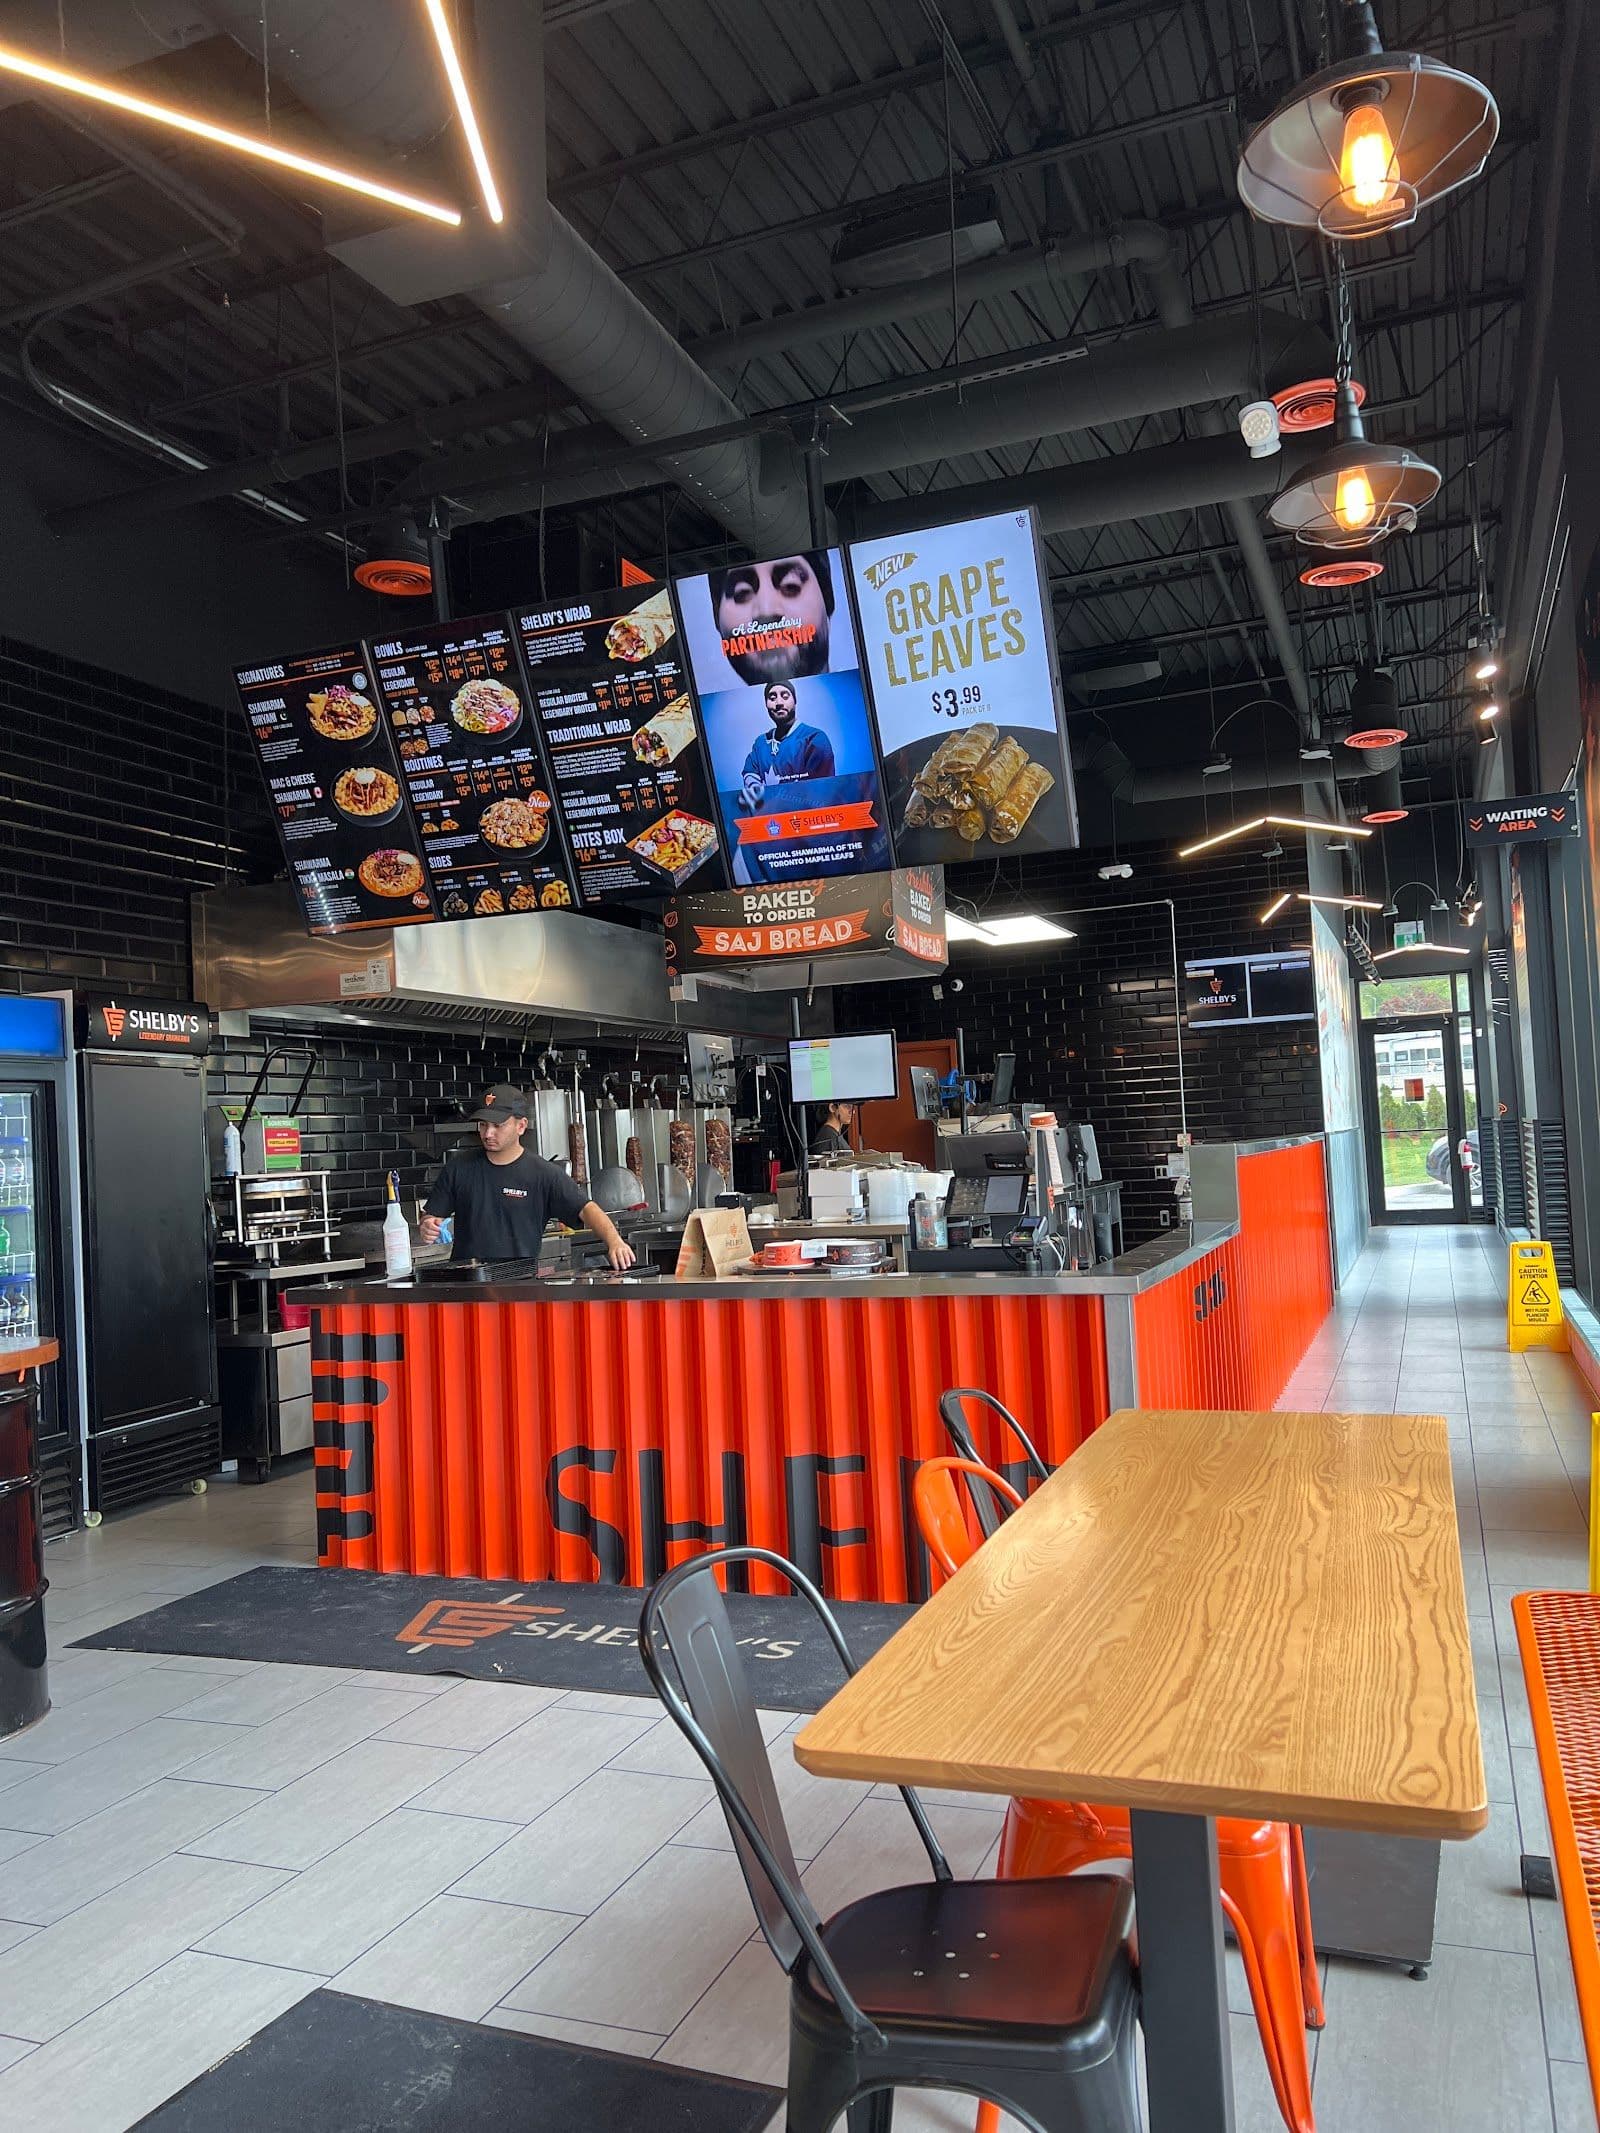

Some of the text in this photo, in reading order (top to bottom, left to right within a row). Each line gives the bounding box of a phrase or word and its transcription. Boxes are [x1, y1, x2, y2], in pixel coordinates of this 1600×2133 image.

[875, 552, 906, 587] NEW
[885, 558, 1010, 636] GRAPE
[521, 605, 592, 630] SHELBY'S WRAB
[732, 616, 803, 636] A Legendary
[721, 624, 816, 657] PARTNERSHIP
[884, 608, 1026, 686] LEAVES
[374, 642, 404, 658] BOWLS
[236, 664, 285, 685] SIGNATURES
[248, 698, 286, 714] SHAWARMA
[932, 685, 982, 718] $3.99
[251, 712, 278, 726] BIRYANI
[546, 718, 632, 744] TRADITIONAL WRAB
[404, 755, 444, 772] BOUTINES
[270, 778, 286, 790] MAC
[292, 773, 316, 786] CHEESE
[274, 789, 312, 804] SHAWARMA
[528, 796, 551, 808] New
[803, 812, 844, 826] SHELBY'S
[1486, 806, 1548, 822] WAITING
[1498, 820, 1537, 832] AREA
[571, 828, 627, 849] BITES BOX
[758, 842, 863, 862] OFFICIAL SHAWARMA OF THE
[768, 852, 854, 868] TORONTO MAPLE LEAFS
[294, 857, 331, 872] SHAWARMA
[428, 855, 452, 869] SIDES
[318, 870, 344, 882] MASALA
[743, 889, 816, 912] BAKED
[910, 889, 931, 911] BAKED
[744, 908, 816, 924] TO ORDER
[910, 907, 918, 918] TO
[714, 920, 852, 952] SAJ BREAD
[902, 926, 942, 957] SAJ BREAD
[1199, 994, 1236, 1004] SHELBY'S
[130, 1010, 200, 1033] SHELBY'S
